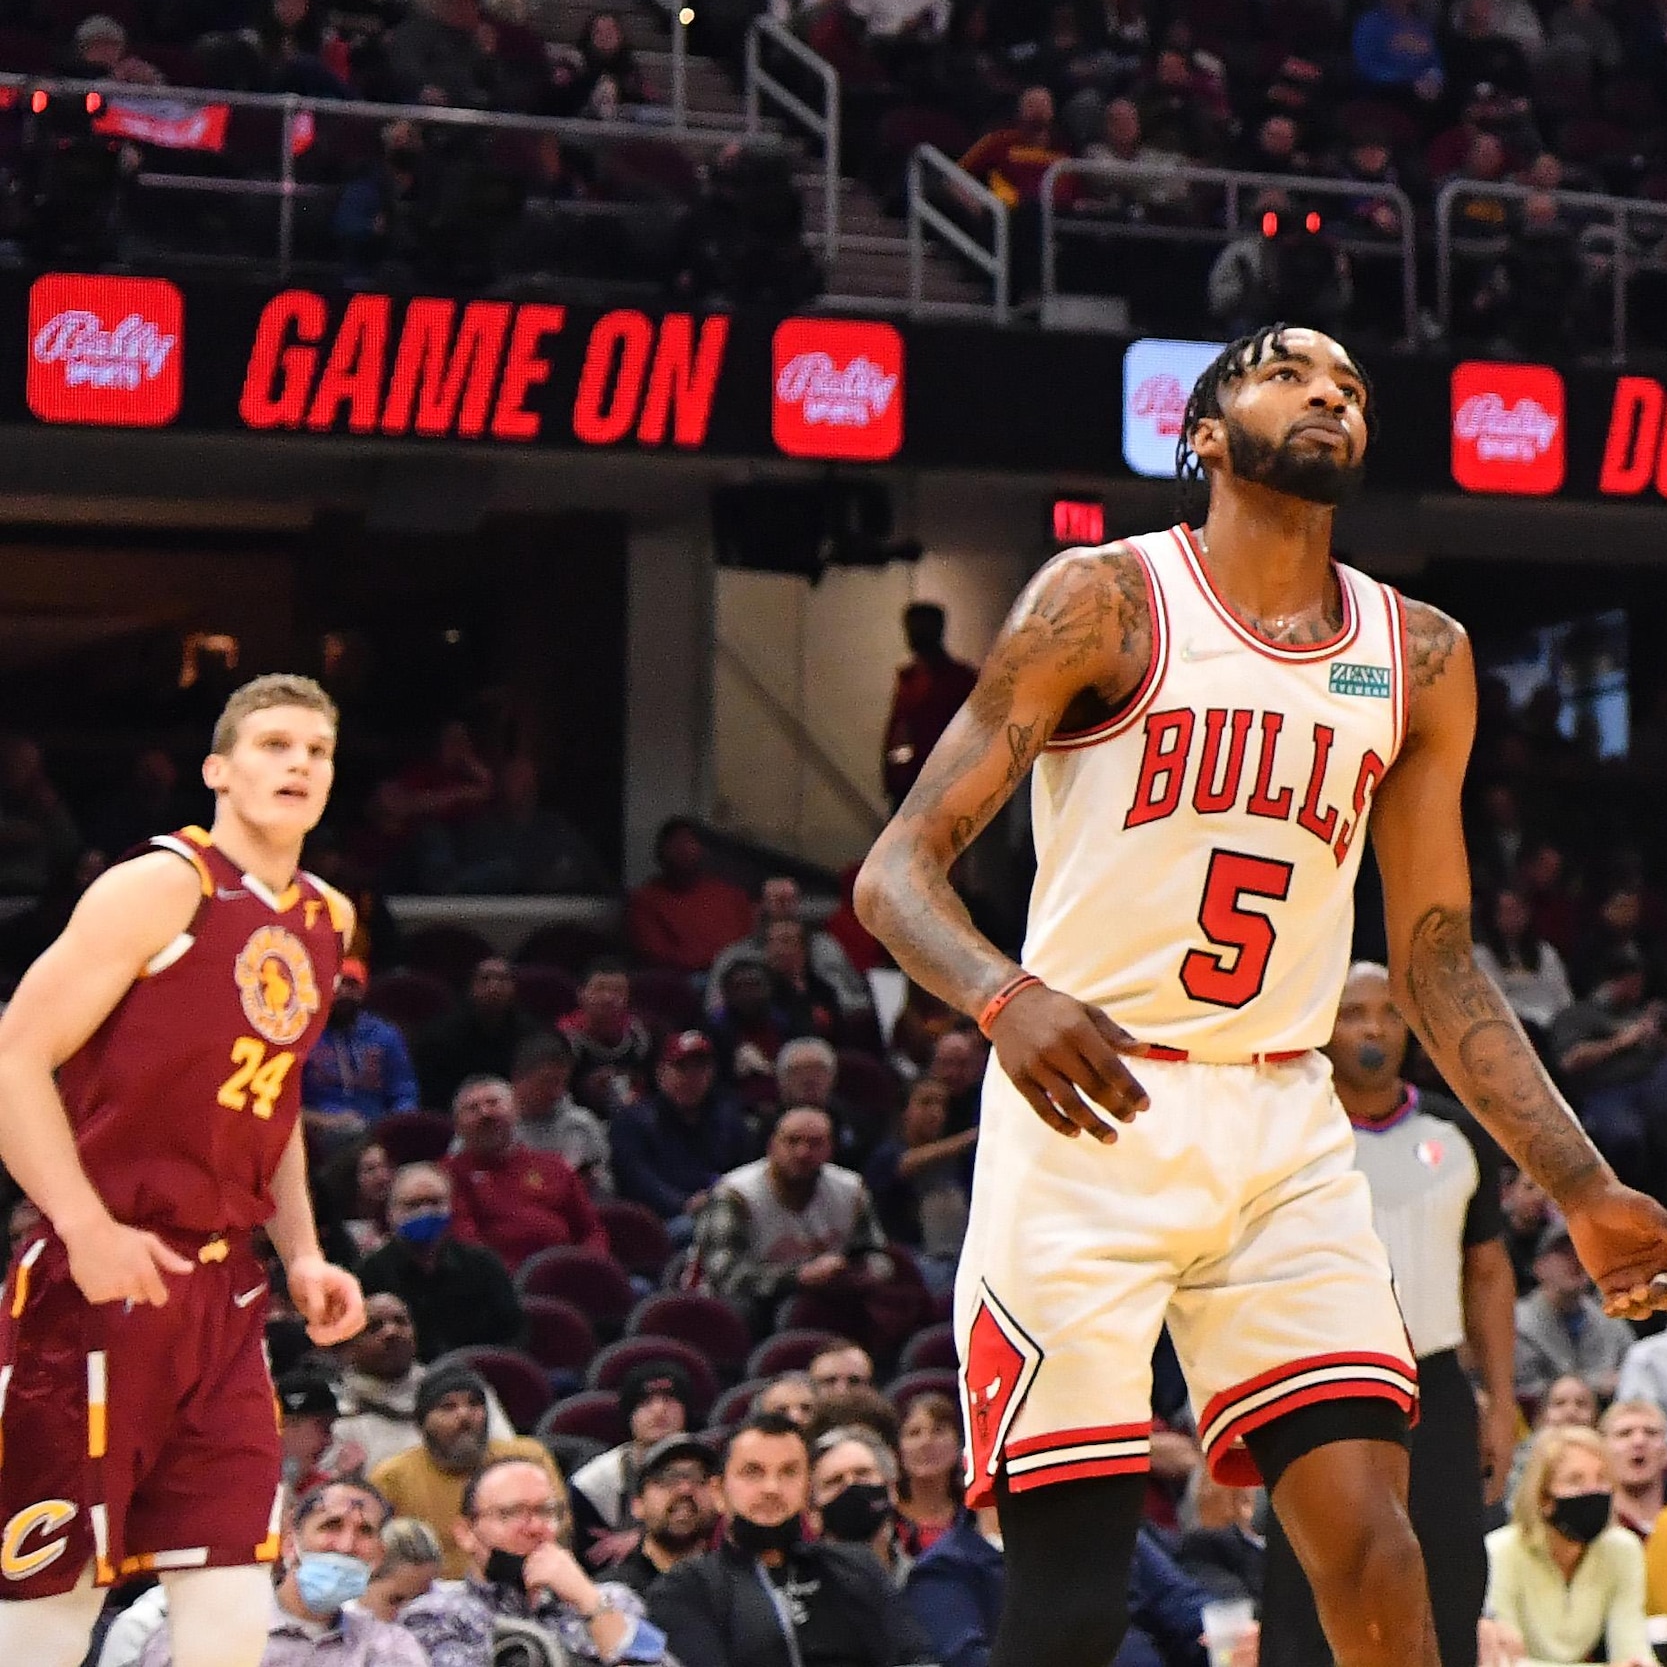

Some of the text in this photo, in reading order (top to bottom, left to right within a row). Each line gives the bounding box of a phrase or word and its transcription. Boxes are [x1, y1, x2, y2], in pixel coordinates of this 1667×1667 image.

[238, 288, 729, 449] GAME ON
[1123, 708, 1386, 869] BULLS
[1180, 848, 1294, 1010] 5
[216, 1036, 296, 1120] 24
